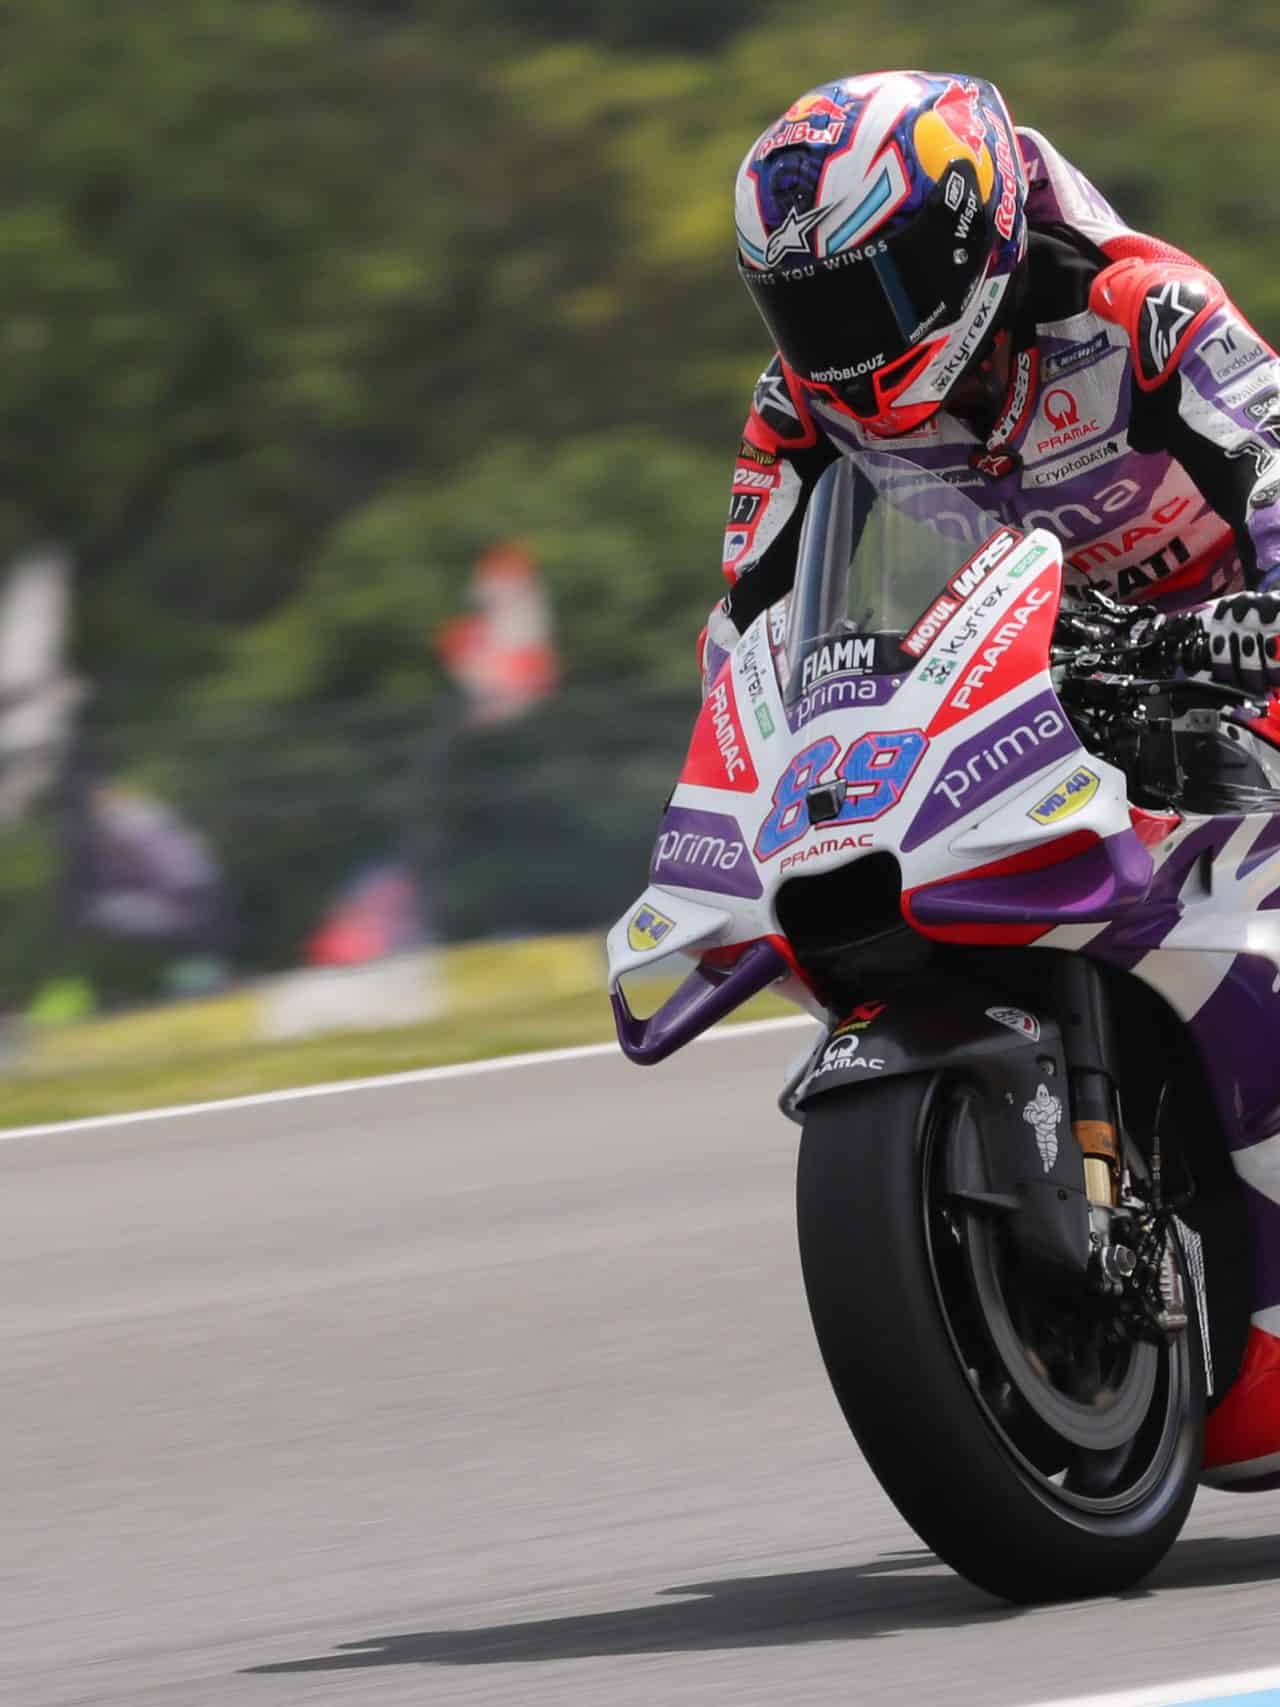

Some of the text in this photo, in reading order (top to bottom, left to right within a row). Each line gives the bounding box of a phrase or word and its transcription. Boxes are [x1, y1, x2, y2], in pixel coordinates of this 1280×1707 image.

[954, 188, 979, 239] Wispr
[782, 265, 815, 281] YOU
[823, 239, 889, 270] WINGS
[810, 352, 886, 382] MOTOBLOUZ
[1036, 419, 1101, 454] PRAMAC
[907, 600, 957, 655] MOTUL
[940, 585, 1009, 655] kyrrex
[802, 638, 875, 688] FIAMM
[950, 587, 1053, 710] PRAMAC
[798, 679, 876, 727] prima
[710, 681, 746, 782] PRAMAC
[933, 709, 1064, 808] prima
[753, 728, 930, 864] 89
[1035, 772, 1091, 817] WD-40
[655, 830, 743, 872] prima
[780, 833, 874, 874] PRAMAC
